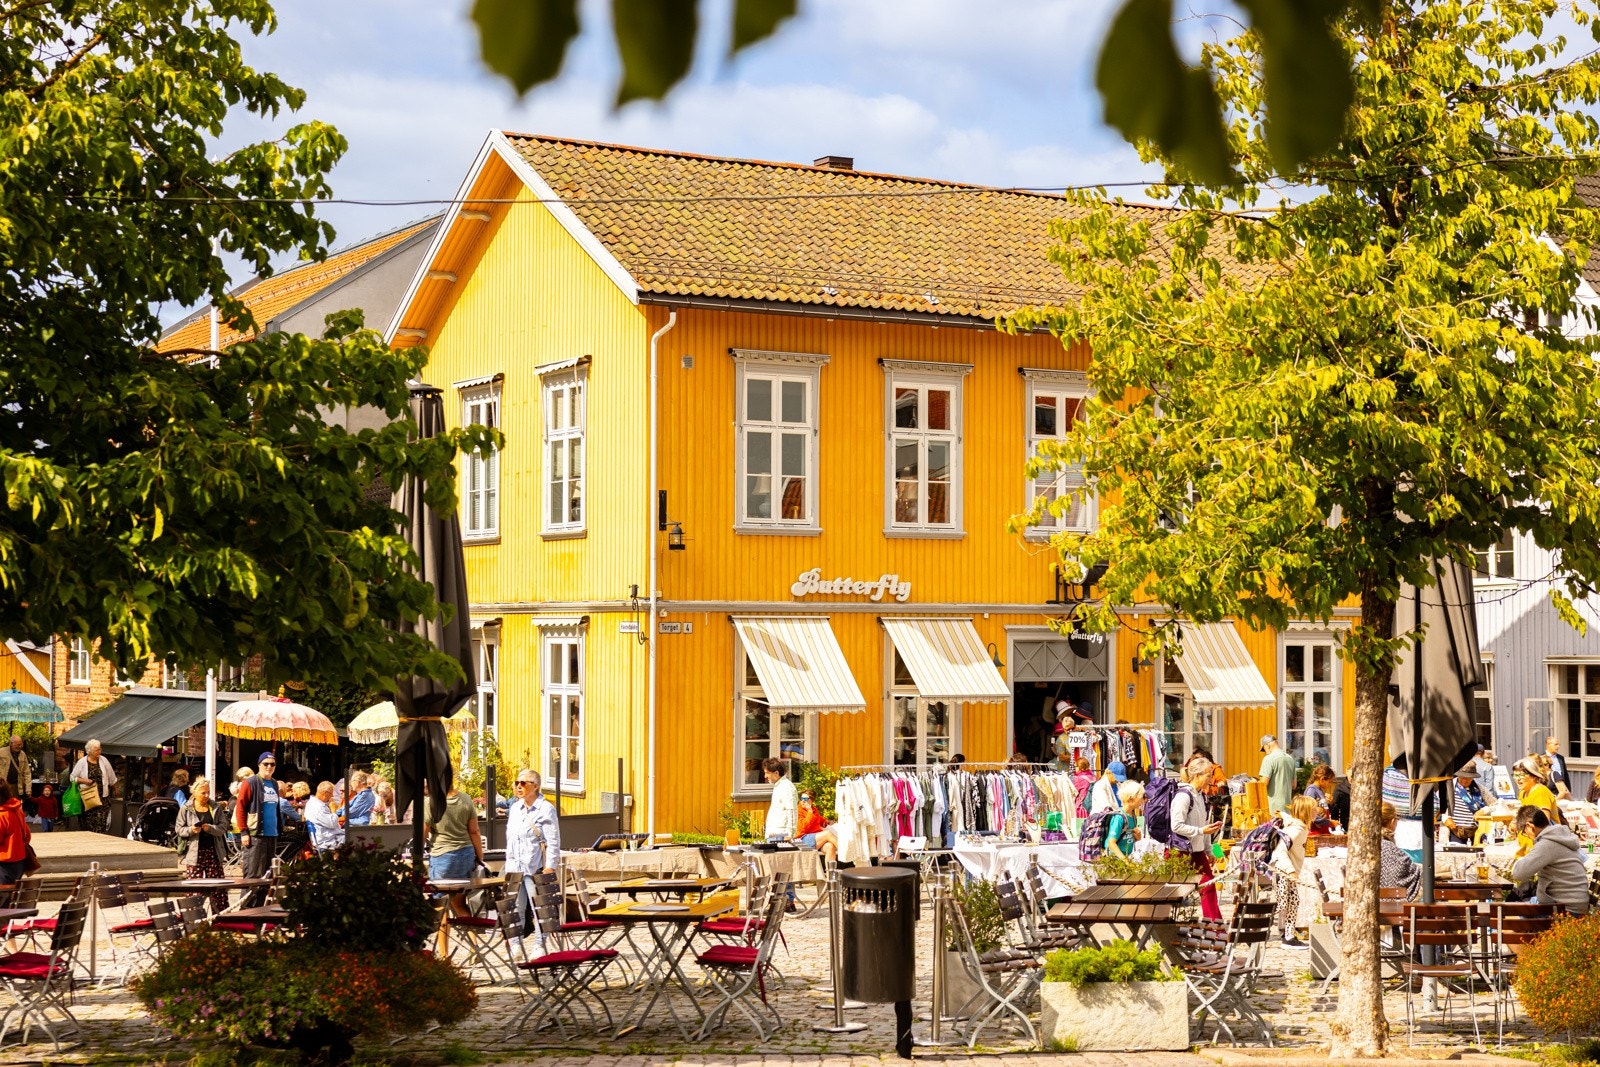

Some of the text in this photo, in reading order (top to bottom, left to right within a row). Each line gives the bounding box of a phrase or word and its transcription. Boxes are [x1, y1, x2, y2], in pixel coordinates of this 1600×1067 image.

[791, 567, 912, 602] Butterfly
[661, 624, 690, 632] Torget 4
[1071, 628, 1103, 644] Butterfly
[1069, 735, 1086, 744] 70%
